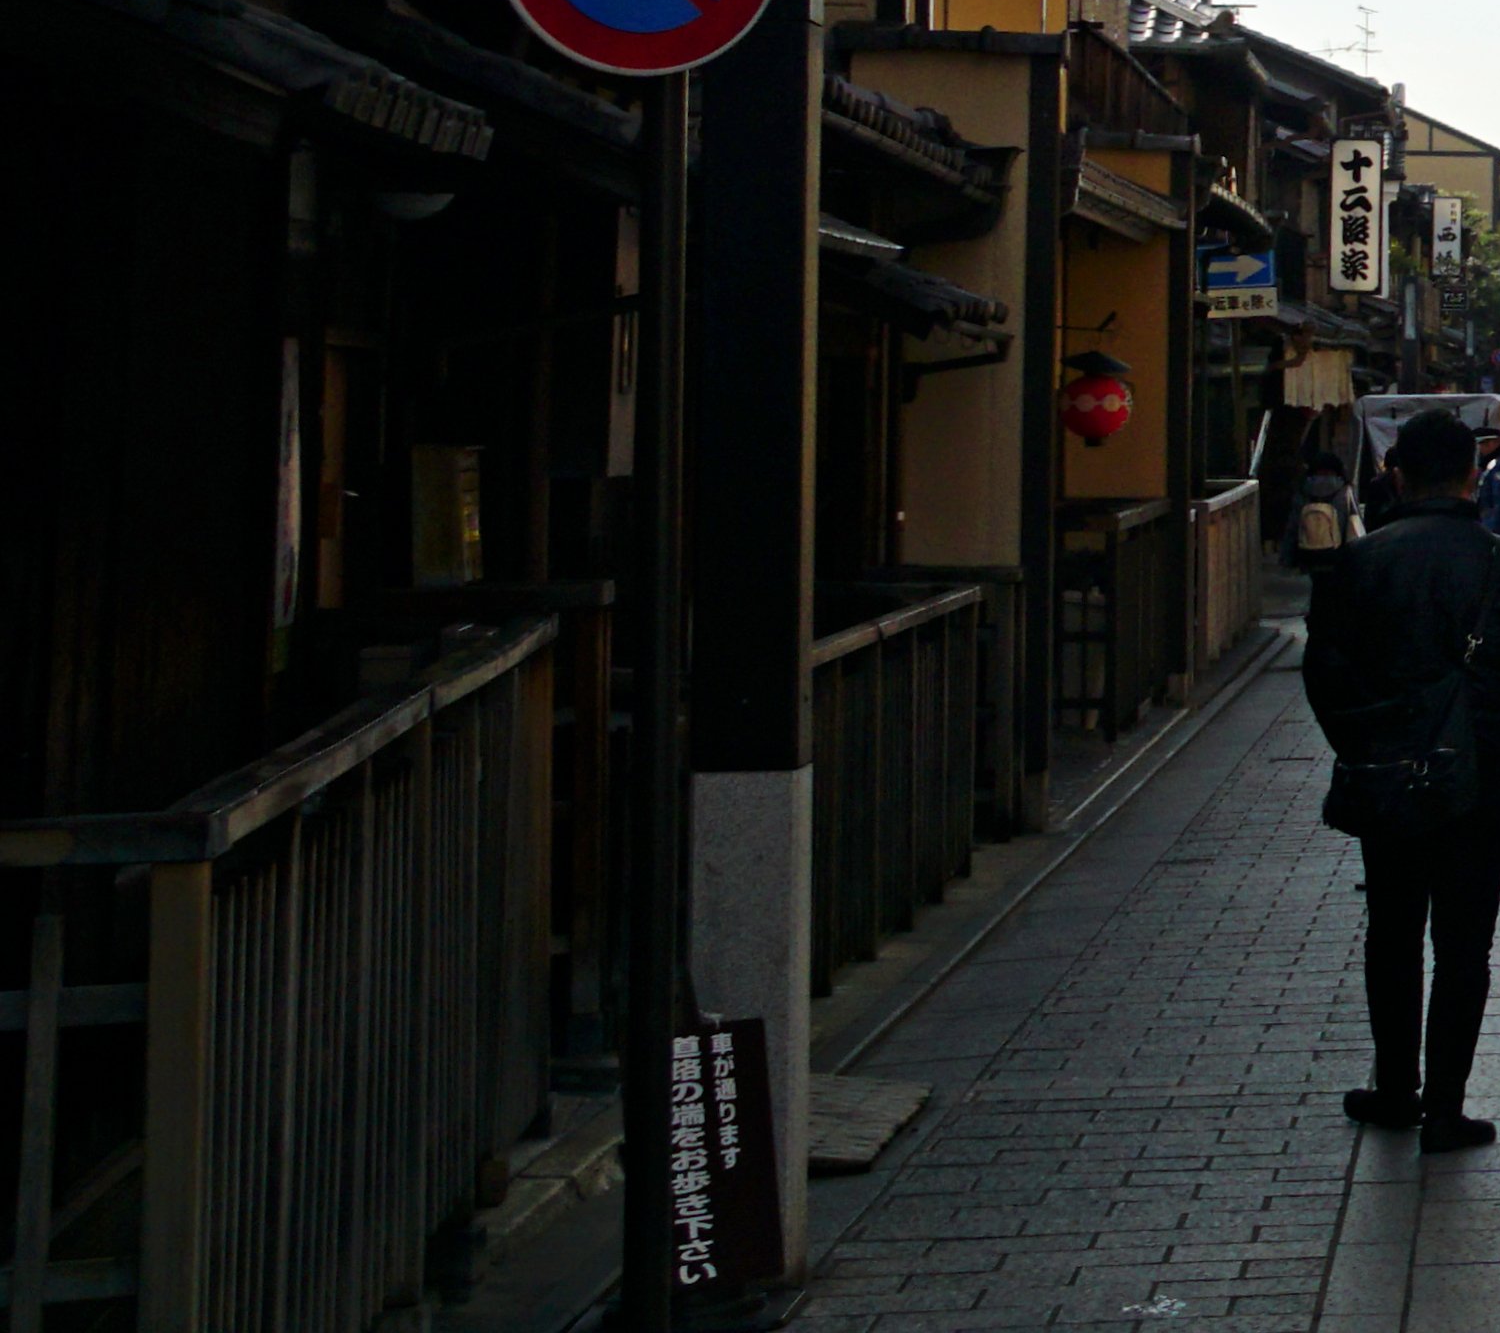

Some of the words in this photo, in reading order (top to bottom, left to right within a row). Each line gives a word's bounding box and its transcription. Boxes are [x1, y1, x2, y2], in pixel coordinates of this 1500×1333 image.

[710, 1032, 741, 1169] 車が通ります
